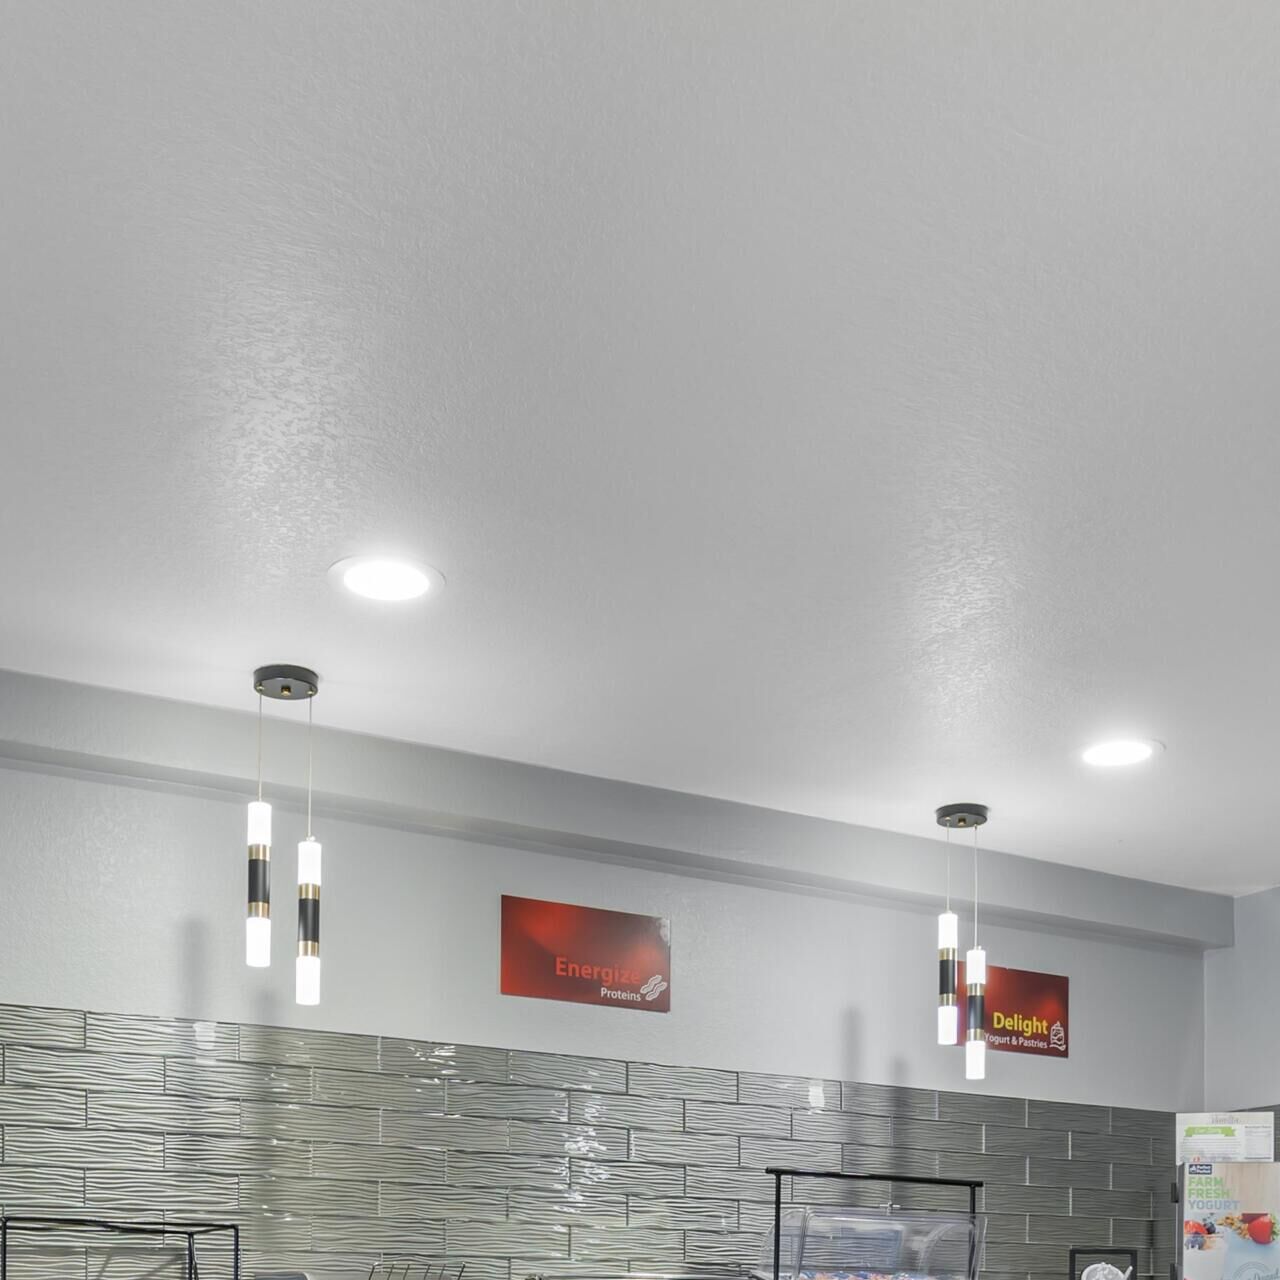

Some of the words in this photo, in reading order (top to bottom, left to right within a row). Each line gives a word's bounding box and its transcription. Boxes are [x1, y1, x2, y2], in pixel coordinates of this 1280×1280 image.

[555, 956, 641, 986] Energize
[600, 986, 641, 1001] Proteins
[993, 1012, 1049, 1037] Delight
[984, 1033, 1010, 1046] Yogurt
[1011, 1036, 1018, 1046] &
[1018, 1037, 1048, 1049] Pastries
[1188, 1176, 1223, 1187] FARM
[1188, 1188, 1231, 1199] FRESH
[1188, 1200, 1239, 1210] YOGURT
